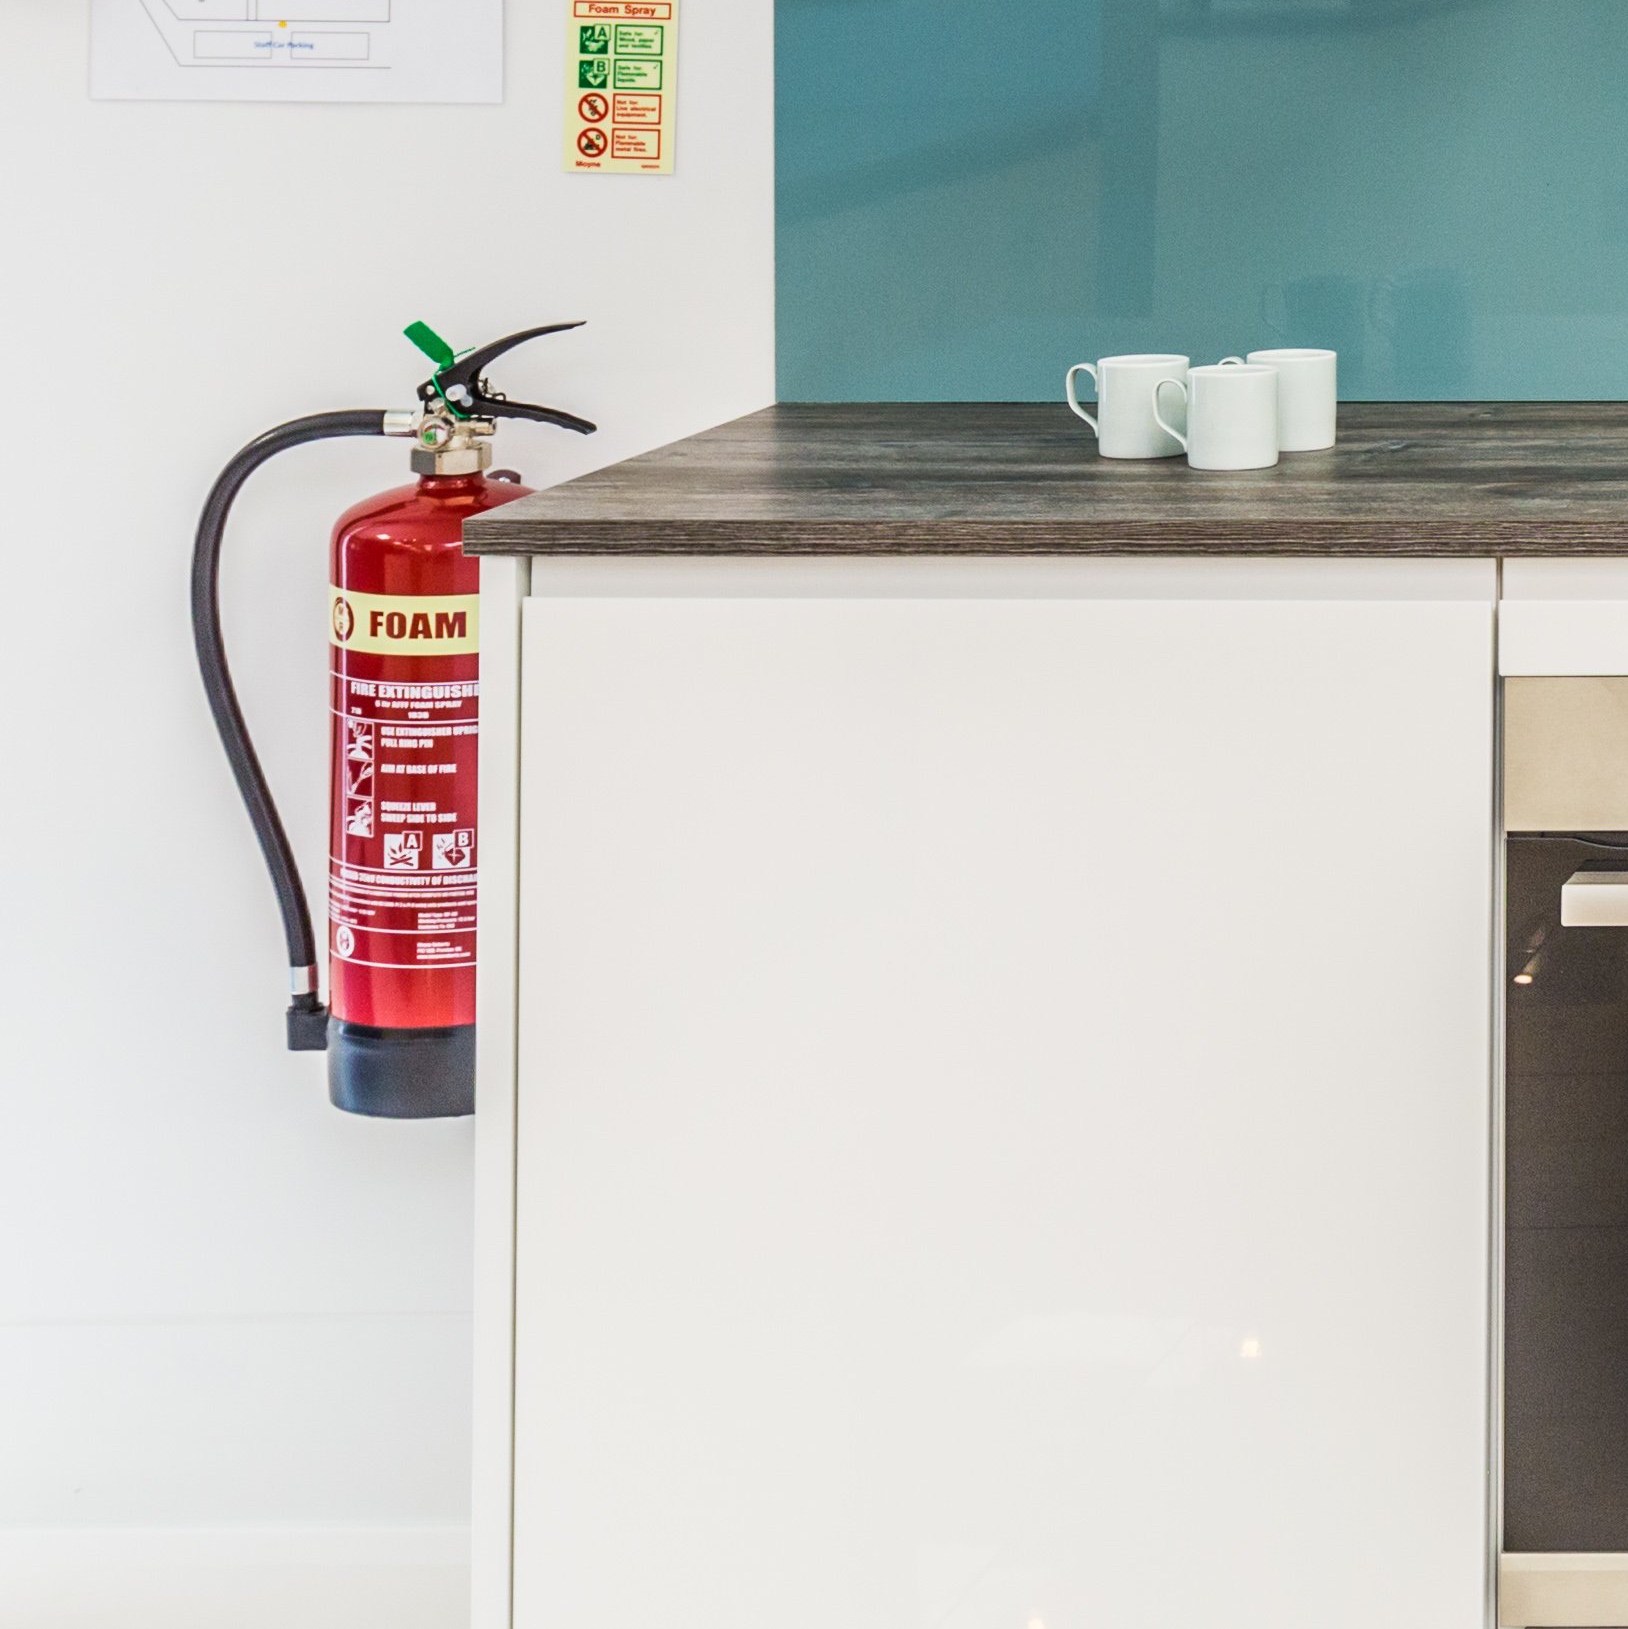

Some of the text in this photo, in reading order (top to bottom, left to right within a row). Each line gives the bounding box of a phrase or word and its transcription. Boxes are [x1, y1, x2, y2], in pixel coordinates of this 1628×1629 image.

[588, 4, 656, 17] Foam Spray
[597, 26, 607, 38] A
[597, 60, 606, 72] B
[370, 610, 467, 639] FOAM
[351, 681, 376, 697] FIRE
[410, 700, 434, 709] FOAM
[435, 700, 462, 709] SPRAY
[396, 726, 452, 737] EXTINGUISHER
[381, 738, 397, 747] PULL
[406, 764, 426, 774] BASE
[439, 763, 457, 773] FIRE
[406, 834, 418, 847] A
[458, 832, 469, 846] B
[376, 874, 431, 885] CONDUCTIVITY
